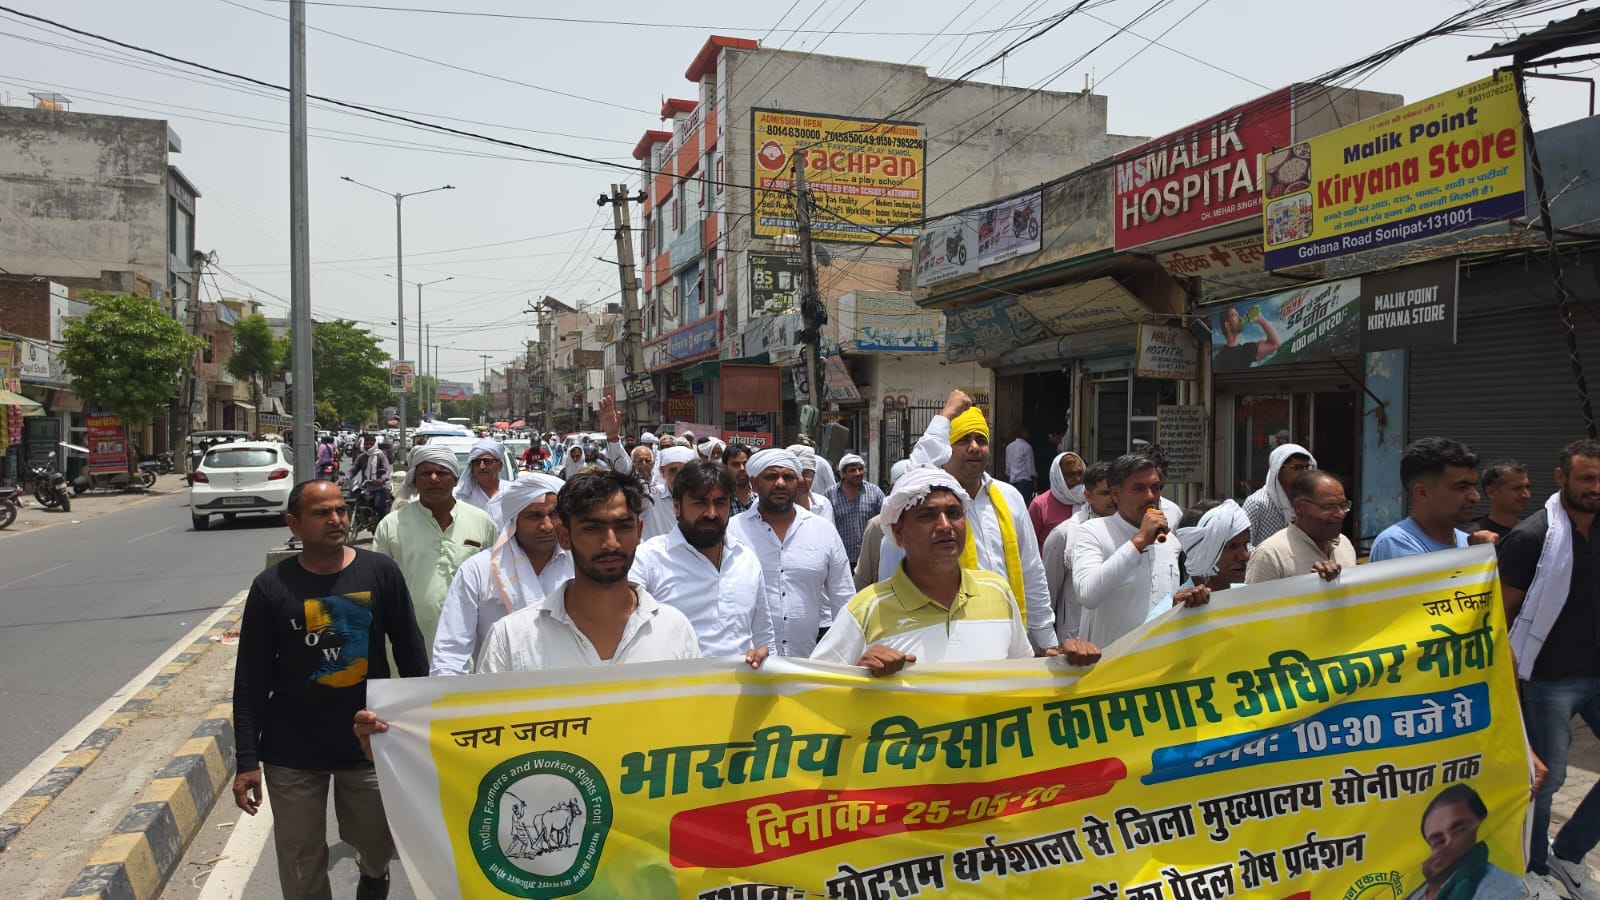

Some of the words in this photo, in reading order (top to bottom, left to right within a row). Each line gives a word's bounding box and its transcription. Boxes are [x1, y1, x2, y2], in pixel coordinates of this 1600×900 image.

[761, 115, 801, 127] ADMISSION
[803, 118, 823, 128] OPEN
[1343, 130, 1402, 164] Malik
[1410, 106, 1479, 143] Point
[1147, 113, 1245, 182] MALIK
[858, 176, 876, 186] play
[878, 178, 903, 186] school
[1317, 155, 1420, 208] Kiryana
[1428, 127, 1517, 179] Store
[1298, 241, 1340, 259] Gohana
[1342, 231, 1373, 250] Road
[1375, 208, 1473, 243] Sonipat-131001
[1374, 291, 1407, 312] MALIK
[1407, 286, 1439, 306] POINT
[1367, 311, 1411, 331] KIRYANA
[1412, 304, 1445, 324] STORE
[1146, 345, 1184, 358] HOSPITAL
[1151, 330, 1178, 345] MALIK
[1291, 335, 1306, 353] 400
[1307, 328, 1317, 344] ml
[668, 399, 695, 410] FITNESS
[1422, 599, 1454, 616] जय
[1454, 590, 1493, 613] किसा
[619, 724, 852, 800] भारतीय
[862, 705, 1034, 774] किसान
[1044, 676, 1222, 749] कामगार
[1227, 643, 1408, 719] अधिकार
[1416, 611, 1494, 678] मोर्चा
[451, 726, 504, 749] जय
[511, 717, 592, 742] जवान
[1291, 713, 1382, 753] 10:30
[1391, 698, 1446, 739] बजे
[1450, 692, 1474, 730] से
[510, 762, 530, 777] and
[533, 759, 576, 774] Workers
[484, 774, 509, 814] Farmers
[575, 768, 597, 796] Rights
[591, 796, 602, 825] Front
[746, 793, 889, 855] दिनांक:
[902, 783, 1066, 825] 25-05-26
[952, 830, 1084, 882] धर्मशाला
[1082, 815, 1114, 856] से
[1114, 804, 1196, 850] जिला
[1199, 777, 1323, 843] मुख्यालय
[1330, 764, 1437, 807] सोनीपत
[1441, 753, 1483, 785] तक
[479, 817, 492, 851] Indian
[1160, 863, 1233, 900] पैदल
[1238, 848, 1278, 890] रोष
[1355, 873, 1387, 890] एकता
